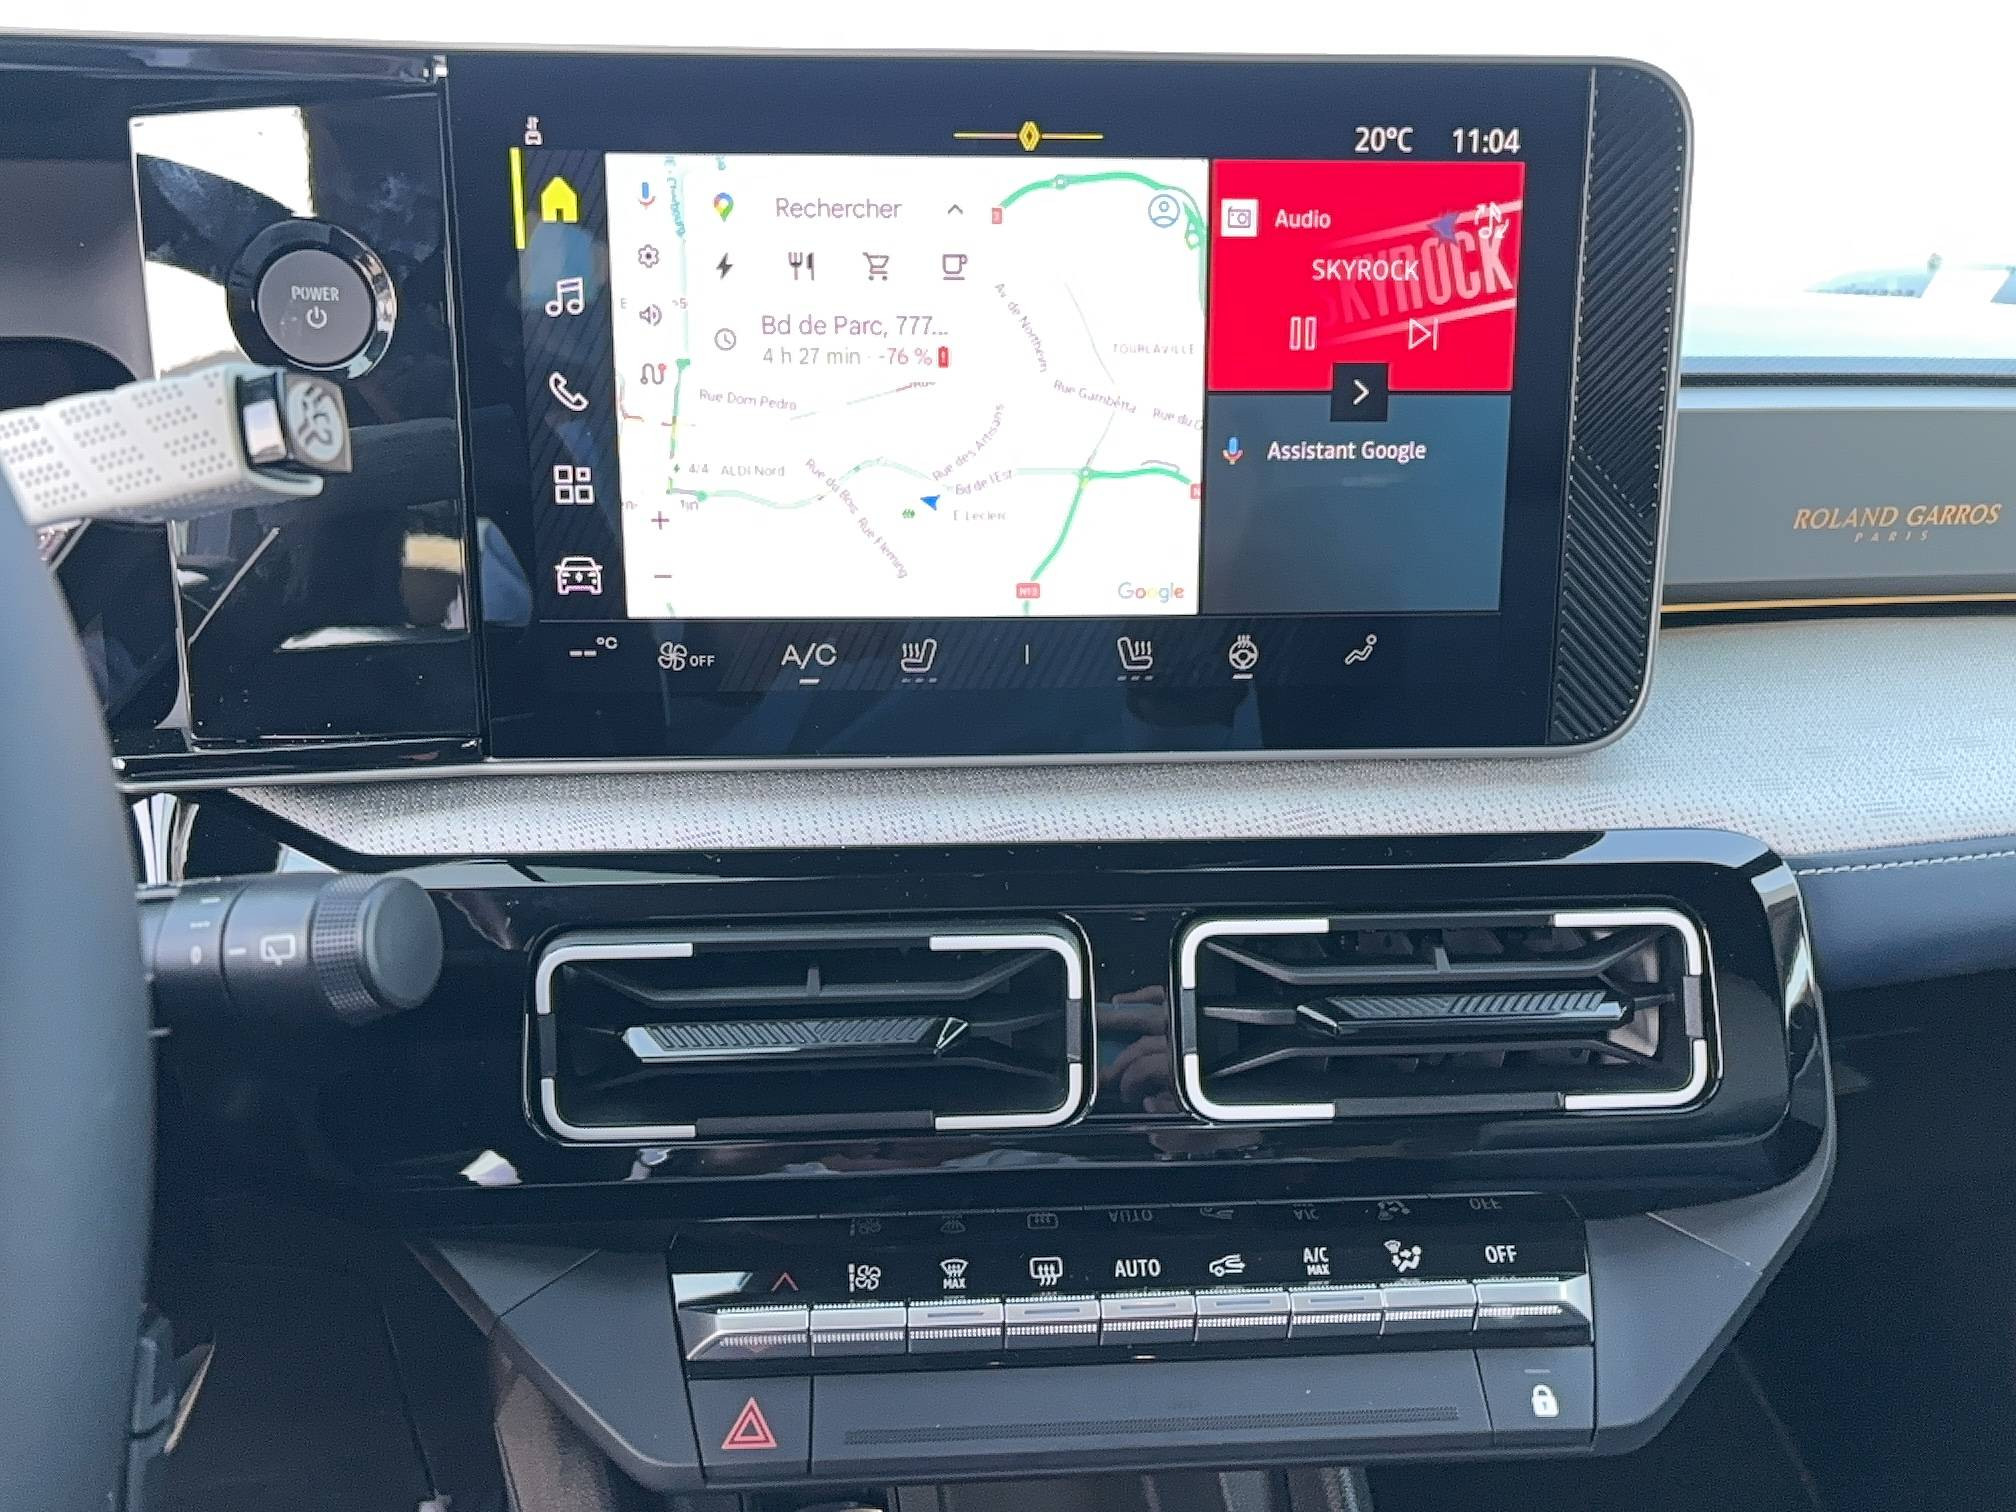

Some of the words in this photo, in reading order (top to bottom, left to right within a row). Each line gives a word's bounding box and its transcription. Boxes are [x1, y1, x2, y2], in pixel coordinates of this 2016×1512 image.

[1355, 127, 1413, 153] 20°C
[1452, 128, 1520, 153] 11:04
[776, 197, 902, 218] Rechercher
[1275, 209, 1331, 228] Audio
[1312, 259, 1419, 280] SKYROCK
[291, 286, 340, 301] POWER
[762, 314, 791, 335] Bd
[799, 314, 827, 335] de
[834, 316, 888, 338] Parc,
[896, 316, 949, 335] 777...
[763, 348, 773, 364] 4
[781, 347, 792, 364] h
[799, 348, 820, 364] 27
[827, 347, 861, 365] min
[1054, 379, 1076, 393] Rue
[699, 389, 723, 403] Rue
[727, 392, 757, 407] Dom
[760, 395, 798, 411] Pedro
[1153, 408, 1175, 421] Rue
[1267, 441, 1356, 460] Assistant
[1361, 441, 1426, 463] Google
[721, 465, 751, 477] ALDI
[755, 465, 785, 477] Nord
[1793, 506, 1899, 530] ROLAND
[1906, 503, 2003, 527] GARROS
[1854, 530, 1929, 543] PARIS
[1118, 581, 1184, 603] Google
[690, 655, 716, 668] OFF
[781, 643, 838, 670] A/C
[1303, 1246, 1329, 1263] A/C
[1485, 1245, 1517, 1263] OFF
[1115, 1258, 1161, 1278] AUTO
[1307, 1262, 1330, 1276] MAX
[943, 1277, 967, 1289] MAX
